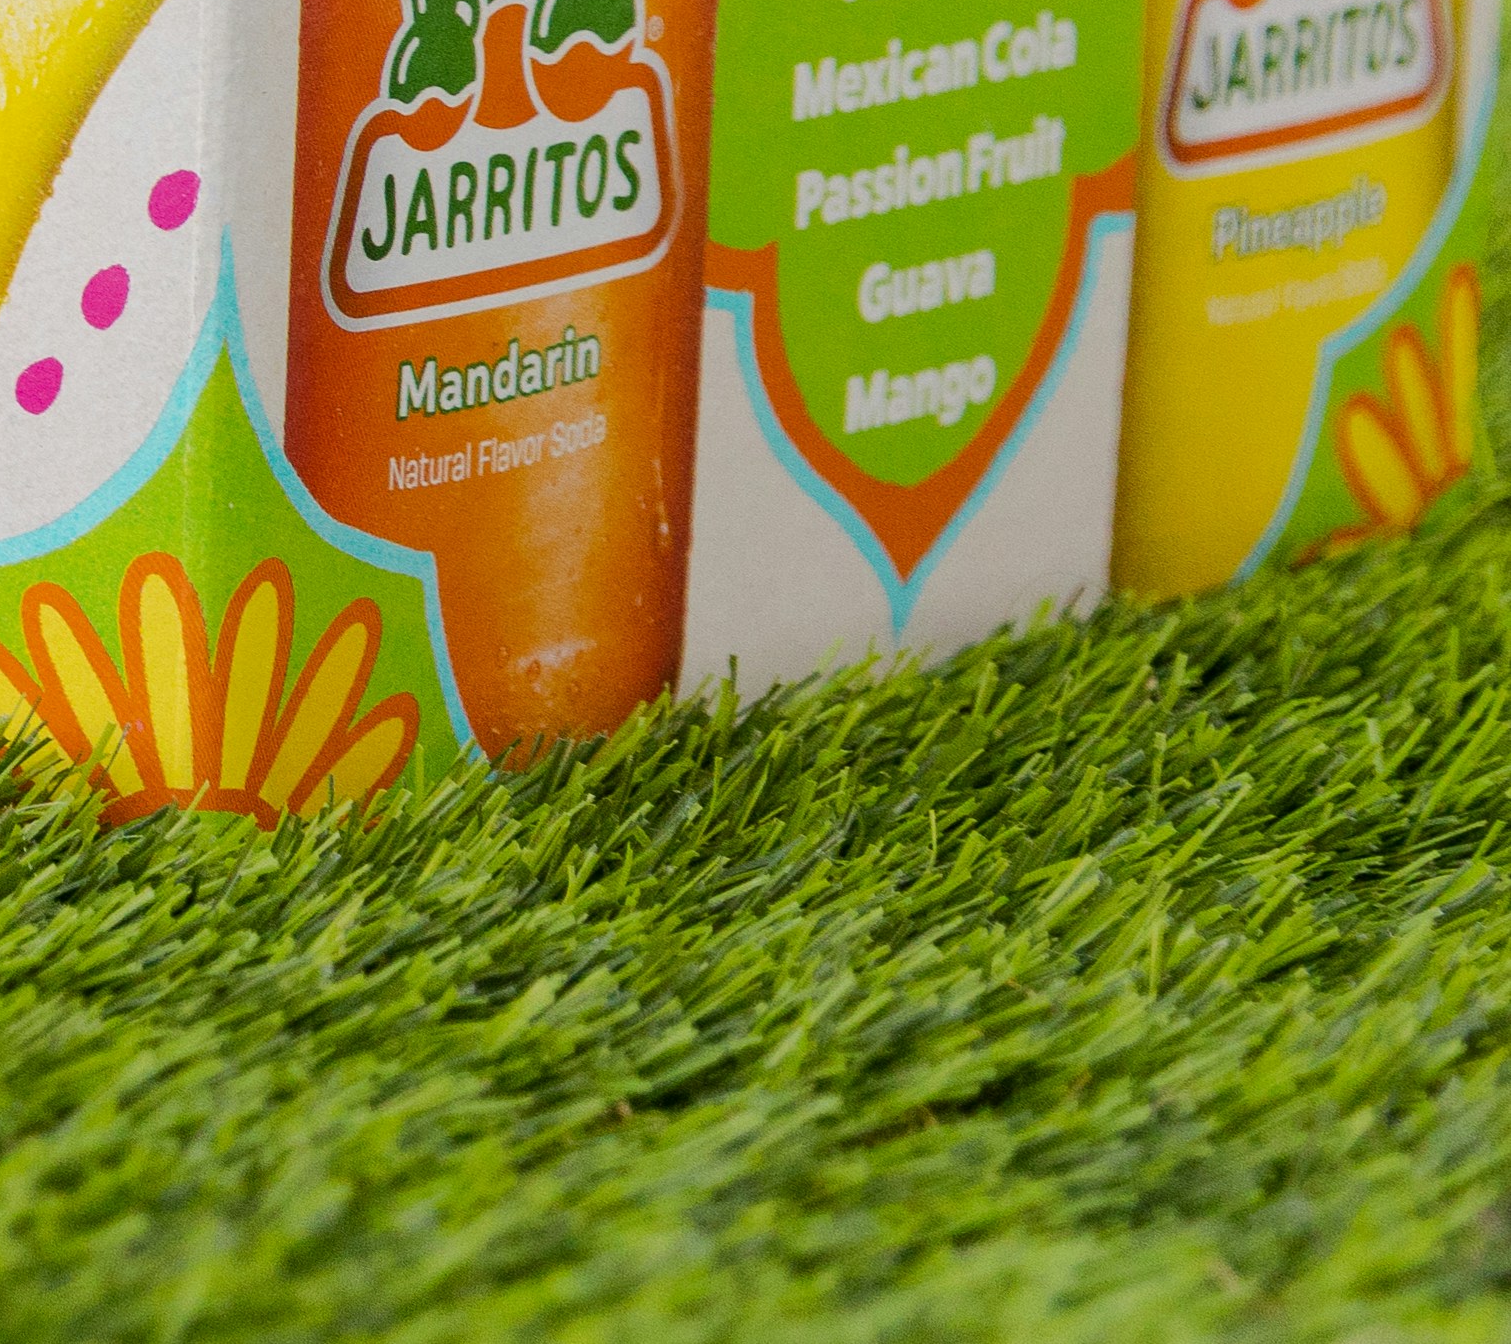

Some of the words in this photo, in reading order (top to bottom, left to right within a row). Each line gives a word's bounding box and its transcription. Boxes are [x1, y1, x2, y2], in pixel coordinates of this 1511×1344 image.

[791, 40, 979, 121] Mexican
[983, 13, 1077, 87] Cola
[362, 130, 640, 263] JARRITOS
[795, 140, 965, 229] Passion
[966, 115, 1066, 185] Fruit
[858, 247, 995, 323] Guava
[396, 324, 600, 421] Mandarin
[844, 349, 995, 435] Mango
[388, 442, 472, 490] Natural
[478, 433, 546, 477] Flavor
[550, 407, 606, 458] Soda
